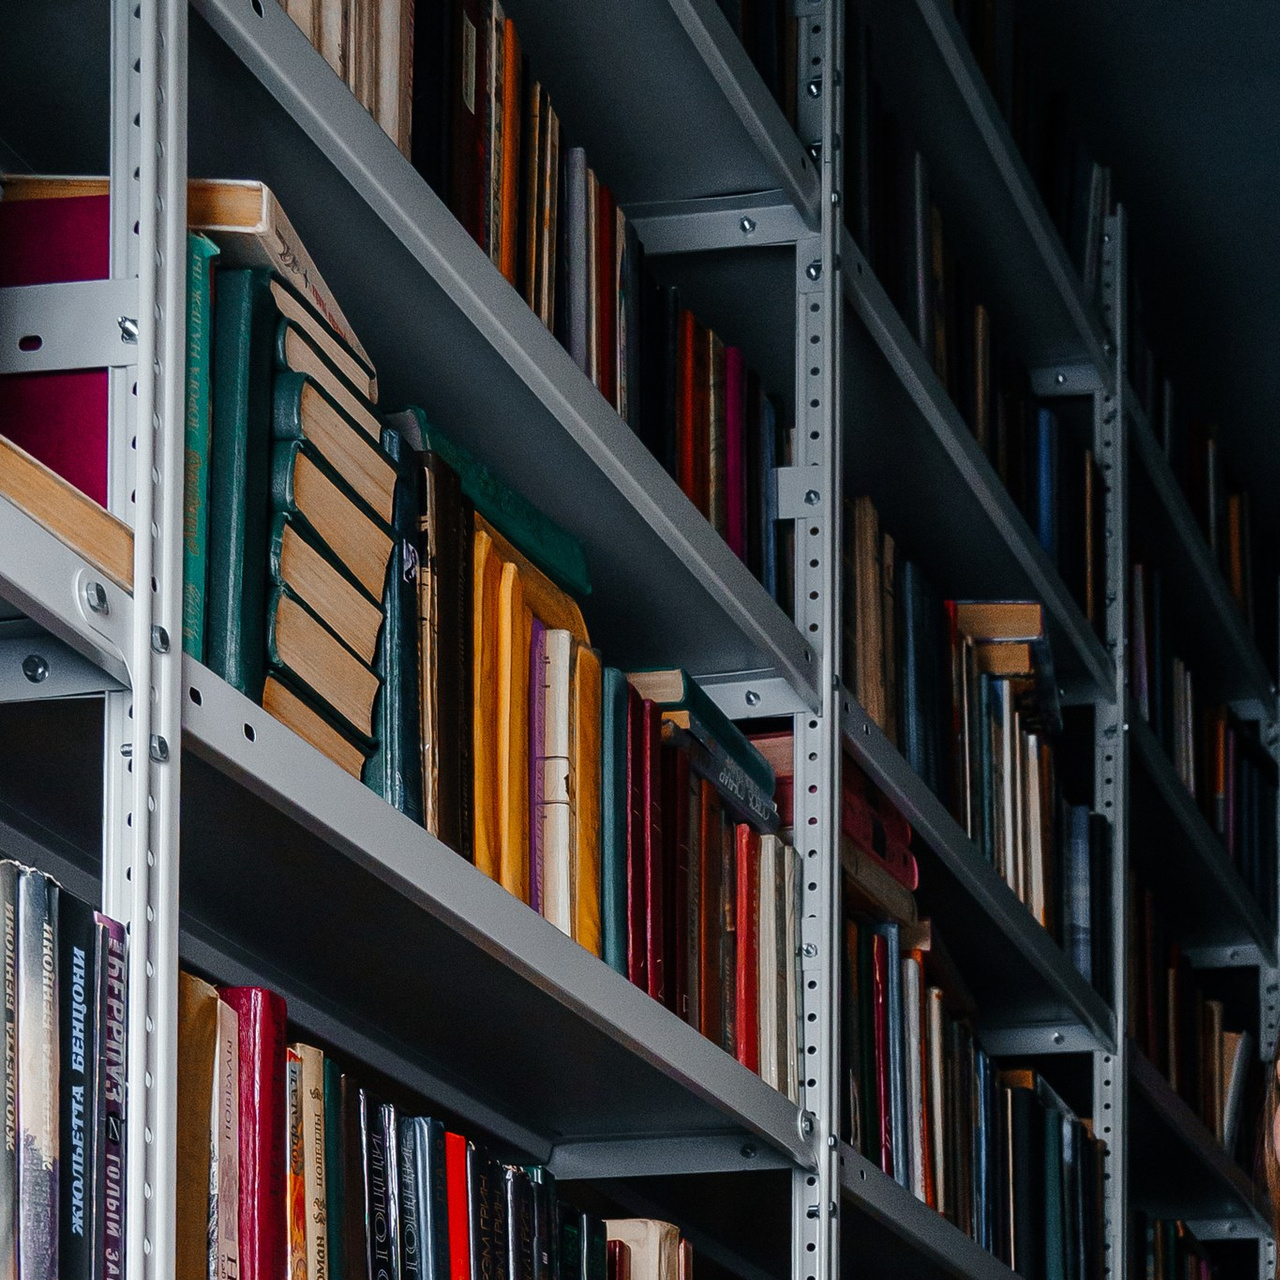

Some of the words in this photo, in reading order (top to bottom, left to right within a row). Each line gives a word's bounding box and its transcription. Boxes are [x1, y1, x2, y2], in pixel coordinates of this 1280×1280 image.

[4, 901, 17, 1014] БЕНЦОНИ
[42, 922, 55, 1034] БЕНЦОНИ
[71, 945, 87, 1075] БЕНЦОНИ
[4, 1021, 16, 1151] ЖЮЛЬЕТТА
[71, 1086, 85, 1238] ЖЮЛЬЕТТА
[106, 1152, 121, 1237] ГОЛЫЙ
[479, 1174, 490, 1231] ГРИН
[493, 1188, 504, 1245] ГРИН
